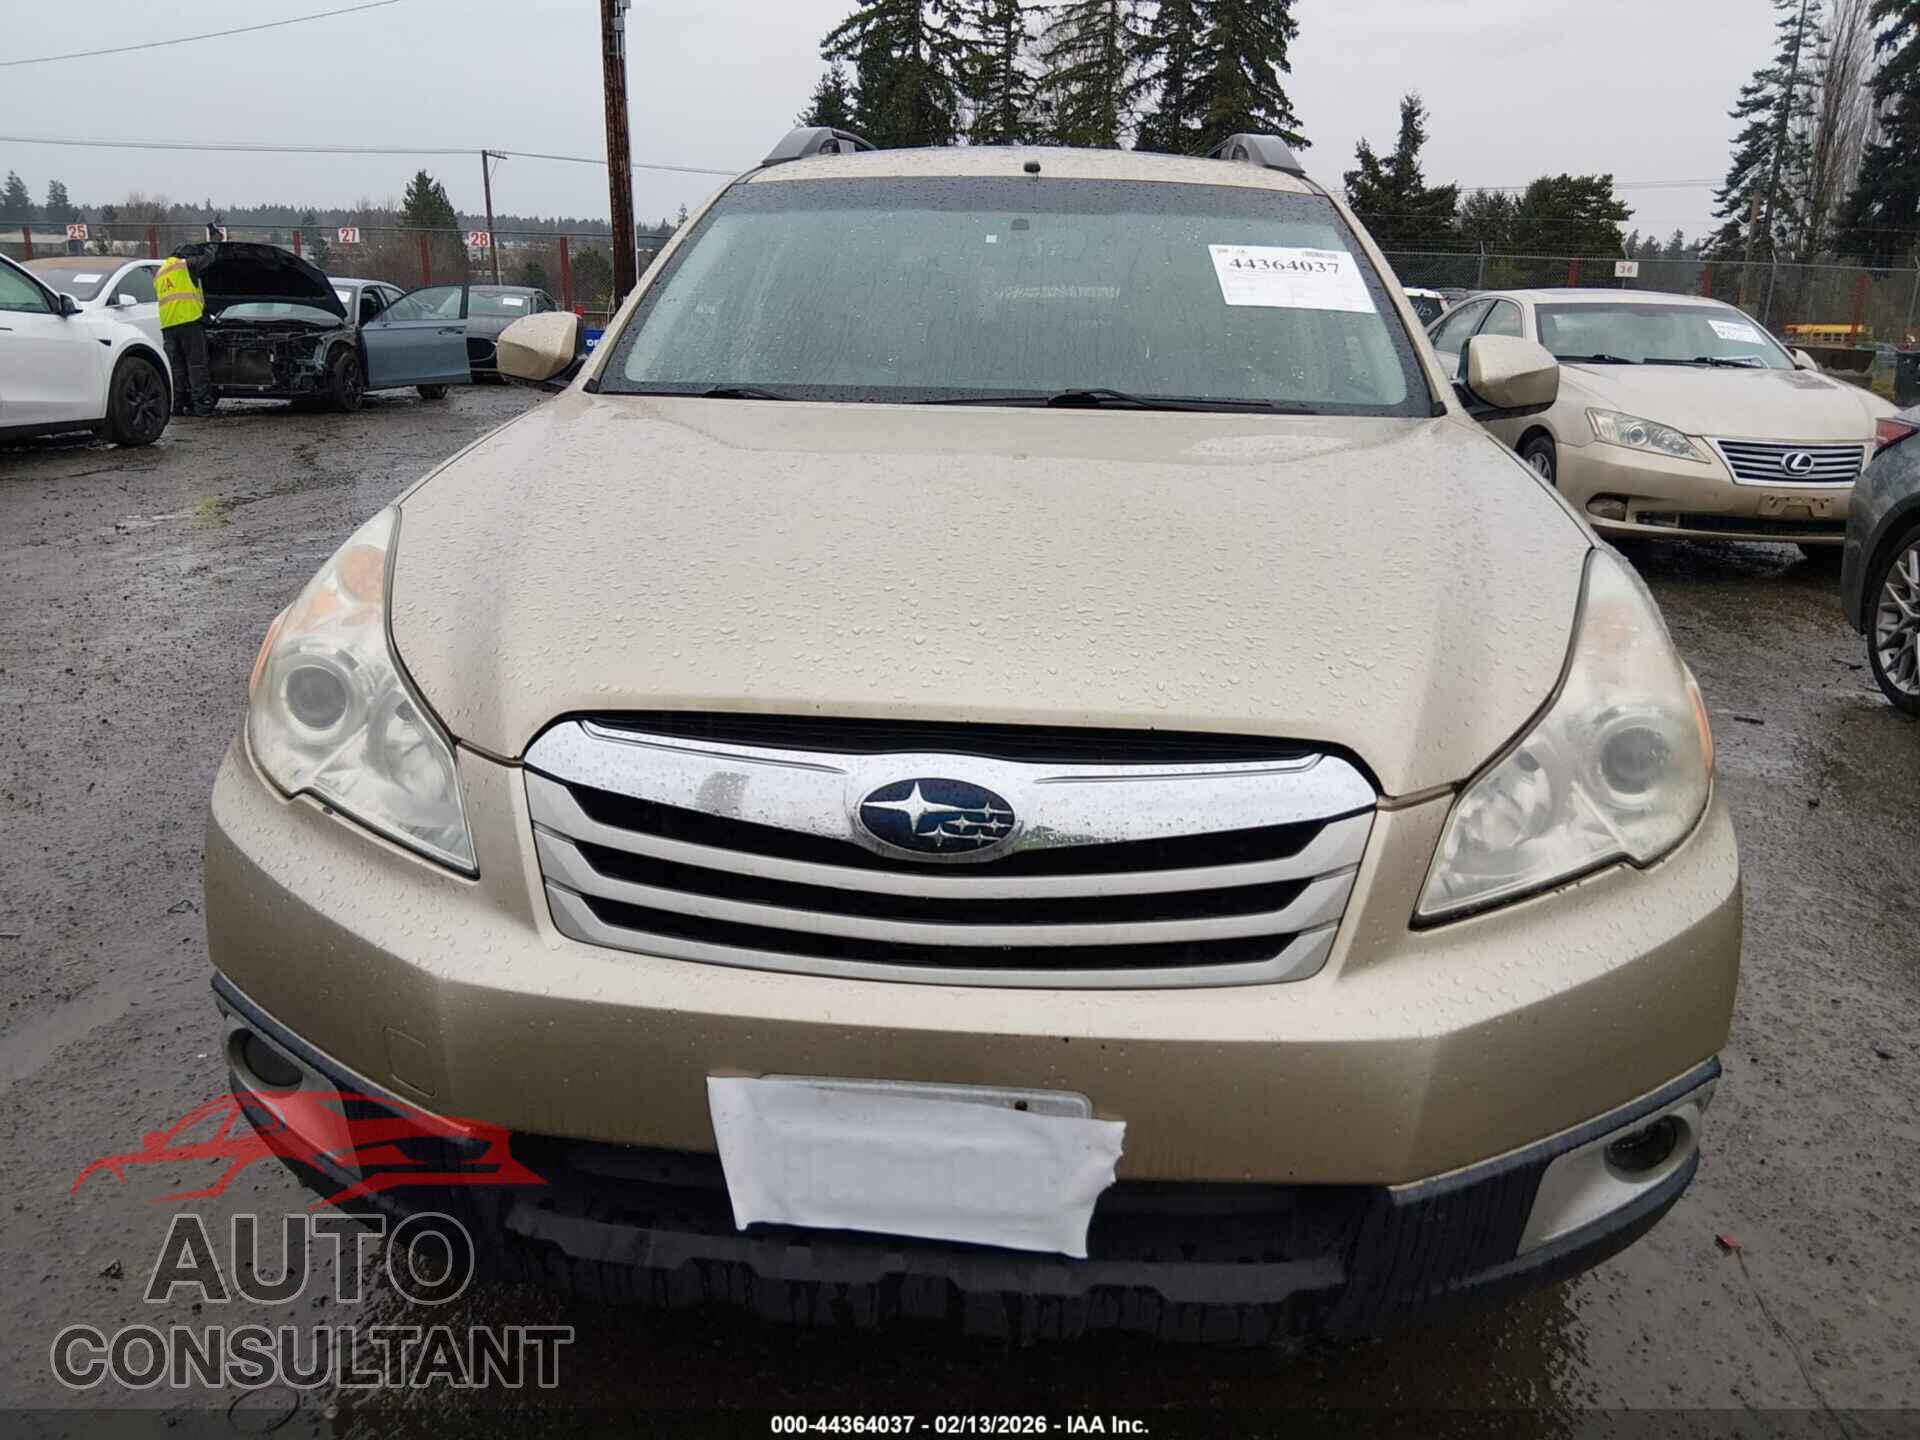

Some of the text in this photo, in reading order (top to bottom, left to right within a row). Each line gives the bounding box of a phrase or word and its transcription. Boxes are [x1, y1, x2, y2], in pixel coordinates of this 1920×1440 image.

[68, 225, 86, 239] 25
[341, 228, 356, 241] 27
[471, 232, 488, 246] 28
[1229, 258, 1339, 274] 44364037
